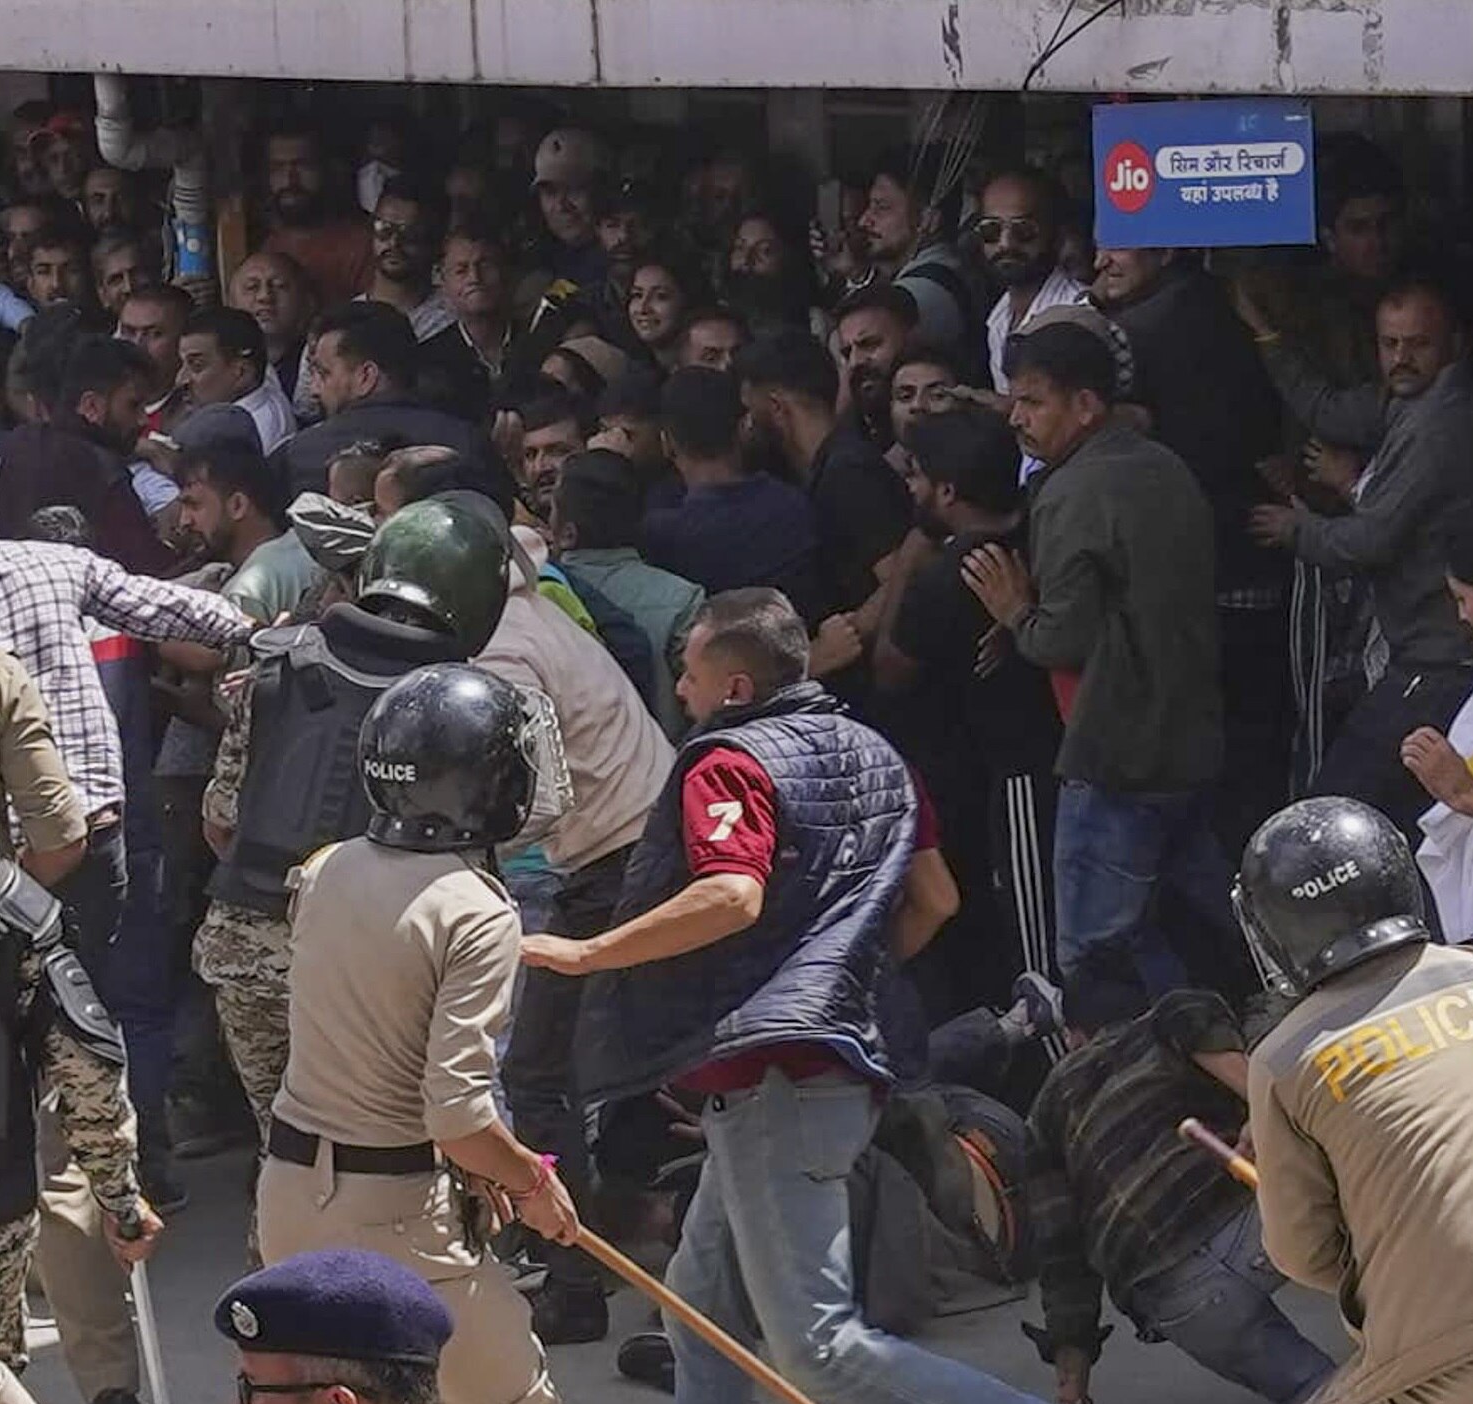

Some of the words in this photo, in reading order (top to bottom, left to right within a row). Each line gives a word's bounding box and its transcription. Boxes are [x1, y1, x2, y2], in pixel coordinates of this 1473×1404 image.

[1203, 149, 1232, 172] और
[1238, 147, 1287, 170] रिचार्ज
[1110, 160, 1149, 191] Jio
[1266, 177, 1279, 202] है
[708, 800, 743, 842] 7
